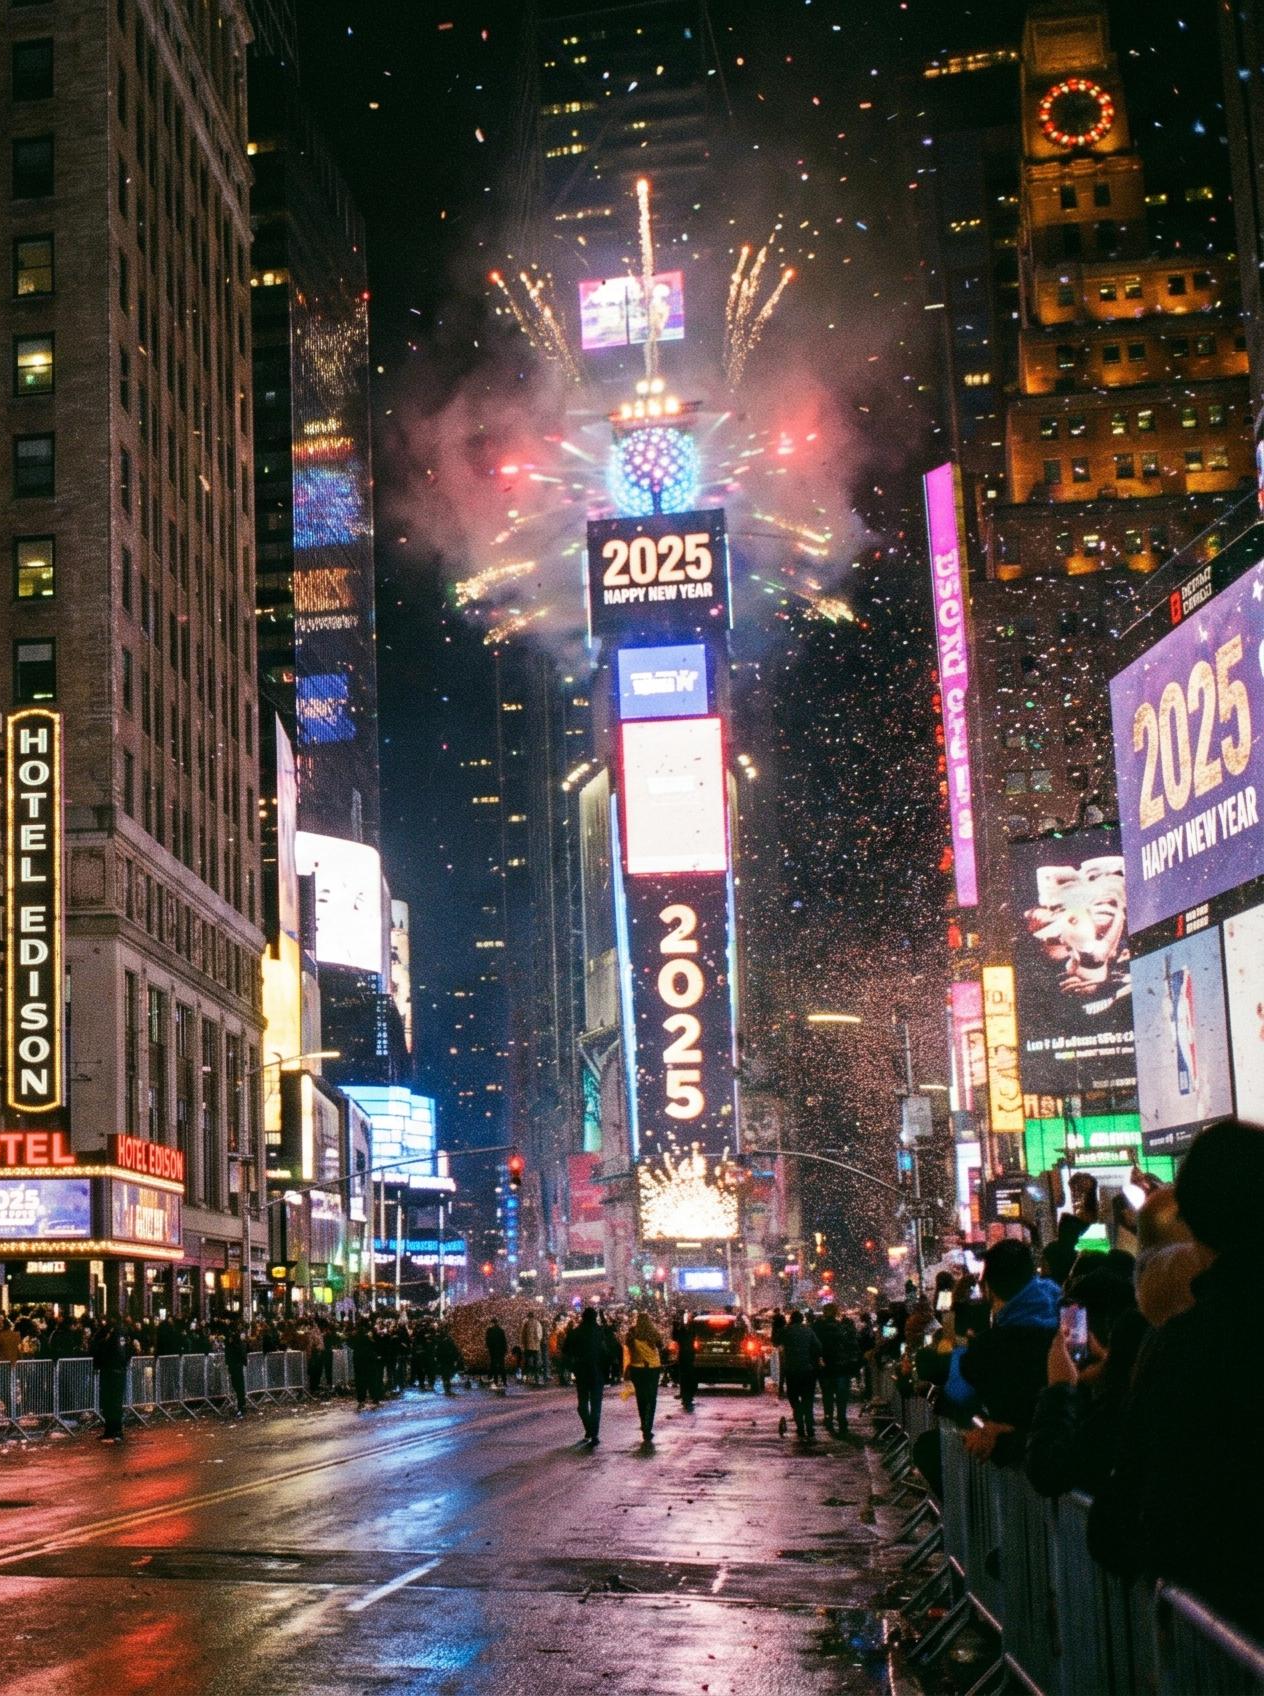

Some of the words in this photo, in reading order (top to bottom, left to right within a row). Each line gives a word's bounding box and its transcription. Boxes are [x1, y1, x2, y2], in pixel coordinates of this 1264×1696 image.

[602, 532, 713, 587] 2025
[603, 586, 646, 605] HAPPY
[648, 584, 678, 602] NEW
[679, 581, 714, 599] YEAR
[1132, 633, 1252, 831] 2025
[18, 727, 51, 883] HOTEL
[1141, 824, 1184, 881] HAPPY
[1185, 806, 1218, 858] NEW
[1217, 785, 1259, 841] YEAR
[18, 905, 51, 1096] EDISON
[656, 903, 706, 1121] 2025
[118, 1134, 148, 1173] HOTEL
[149, 1143, 184, 1181] EDISON
